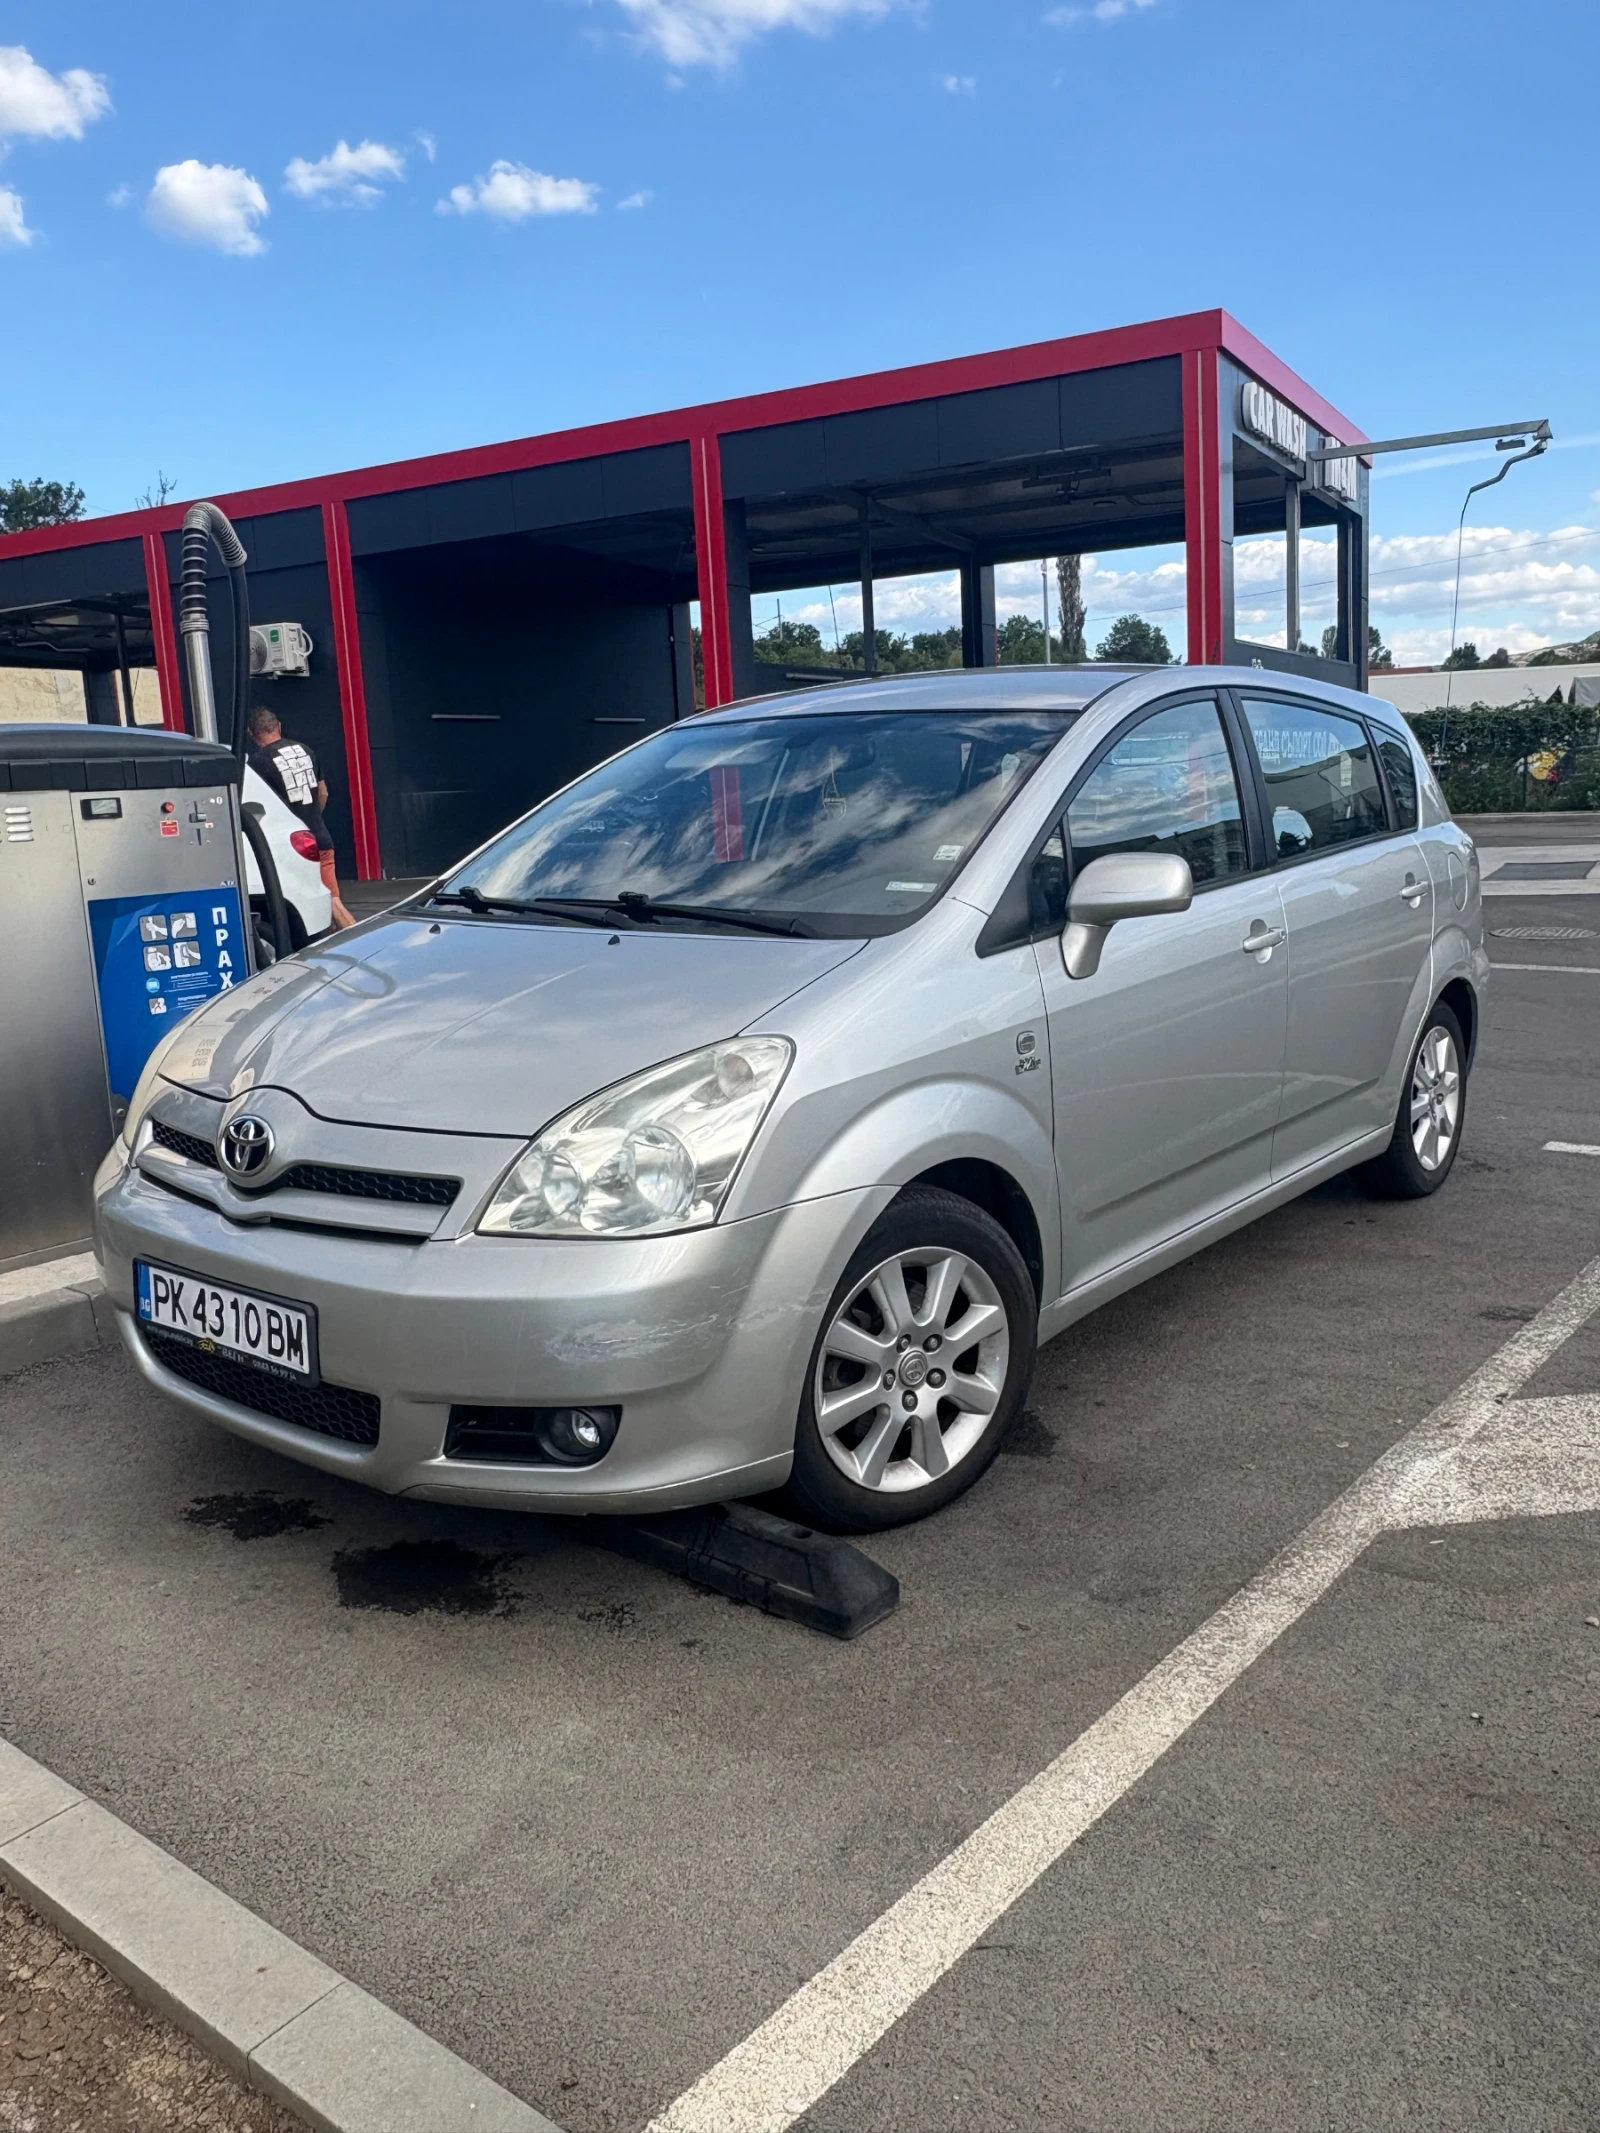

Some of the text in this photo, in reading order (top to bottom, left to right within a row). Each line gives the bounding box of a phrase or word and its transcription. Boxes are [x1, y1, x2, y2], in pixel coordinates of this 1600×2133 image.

[1243, 382, 1307, 463] CAR WASH
[211, 906, 233, 989] ПРАХ
